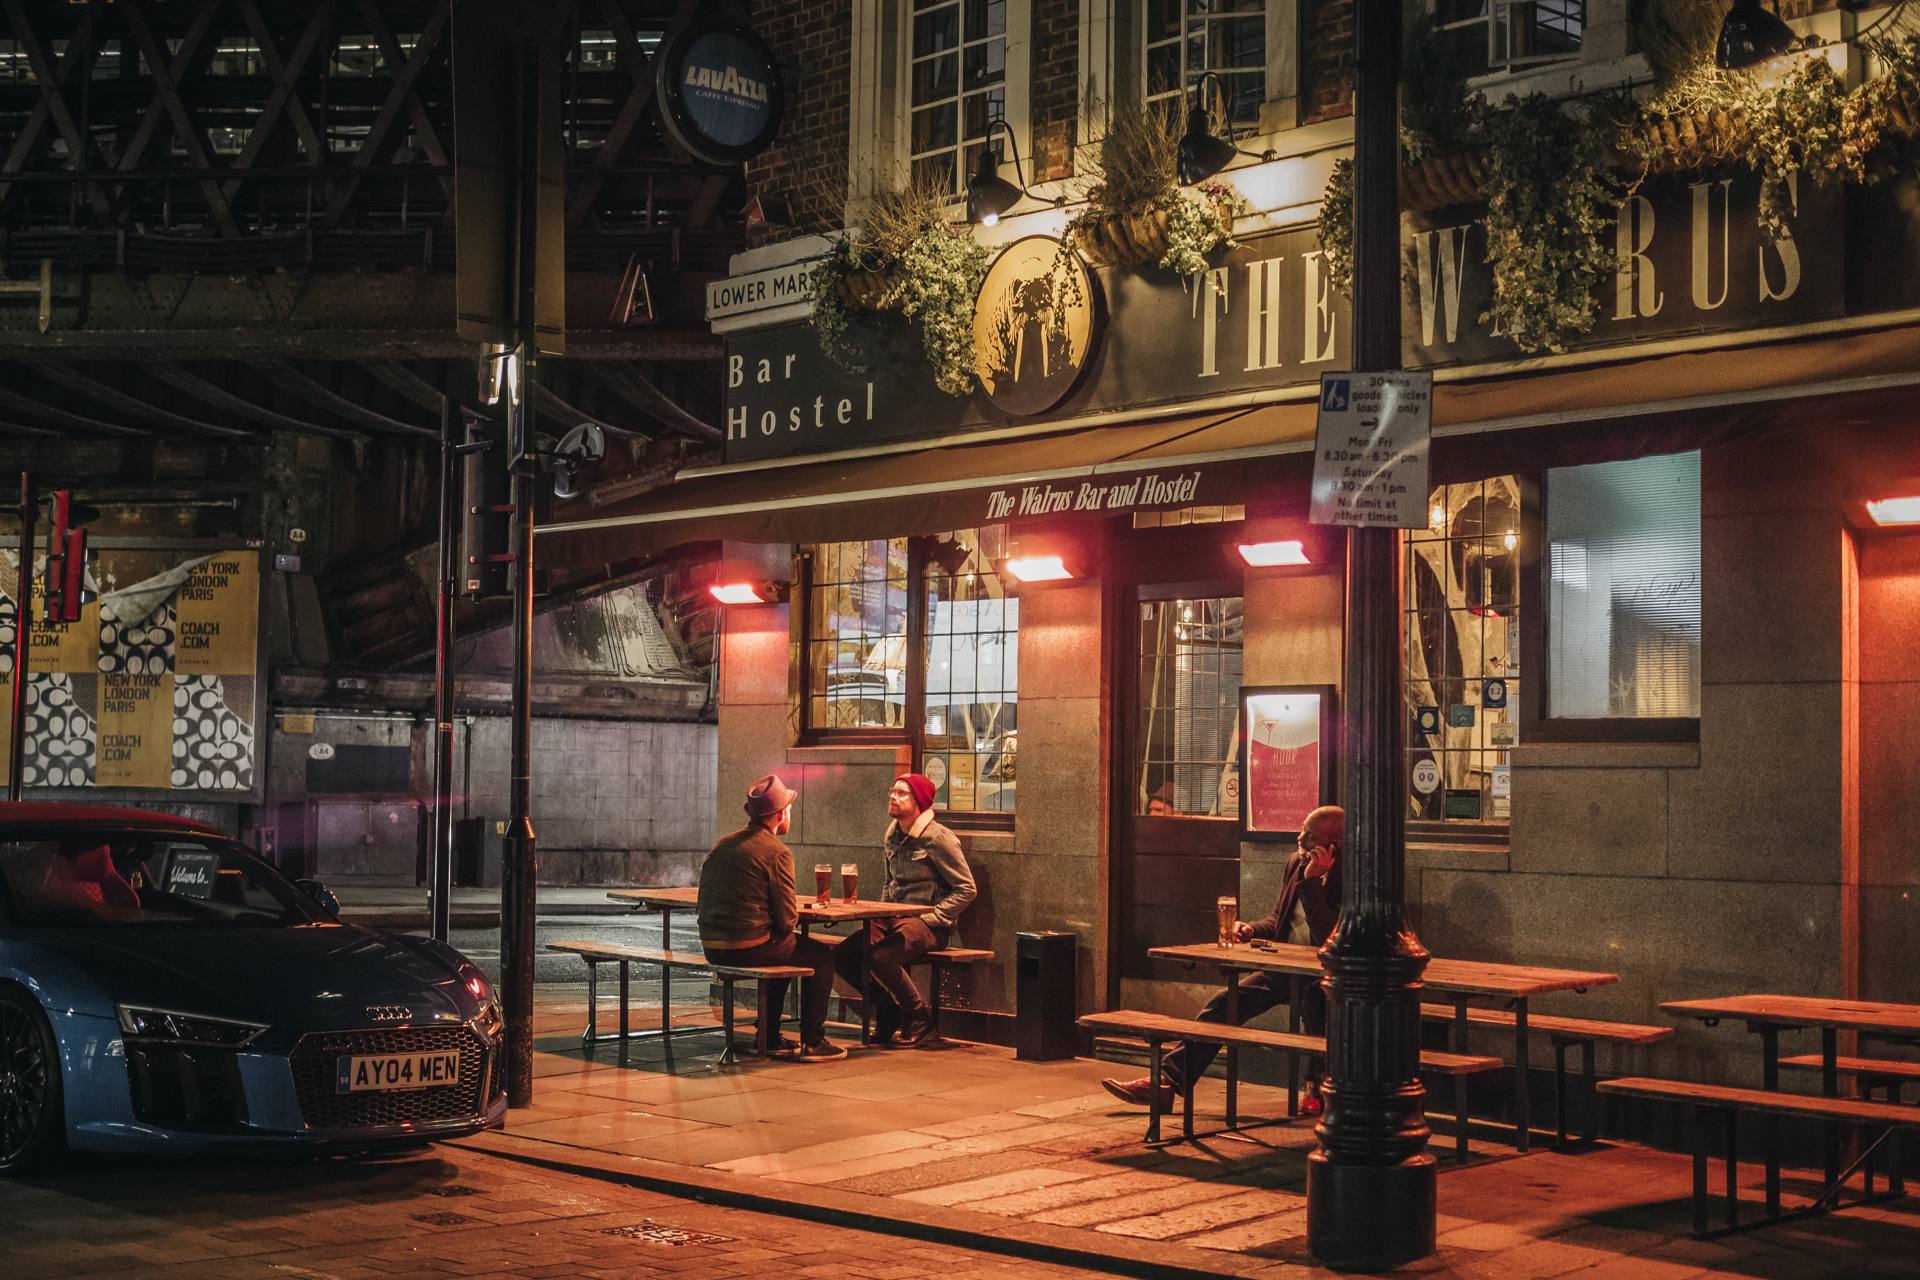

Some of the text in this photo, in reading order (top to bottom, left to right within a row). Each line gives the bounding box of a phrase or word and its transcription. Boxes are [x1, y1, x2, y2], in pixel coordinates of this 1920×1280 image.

[686, 65, 768, 103] LAVAZZA
[1192, 173, 1801, 377] THE WRUS
[713, 281, 766, 309] LOWER
[728, 353, 796, 388] Bar
[1369, 376, 1385, 388] 30
[727, 382, 874, 440] Hostel
[1397, 402, 1421, 416] only
[1348, 436, 1393, 447] Mon Fri
[985, 471, 1202, 520] The Walrus Bar and Hostel
[1337, 497, 1397, 509] No limit at
[1367, 511, 1399, 522] times
[211, 561, 240, 575] YORK
[182, 588, 214, 601] PARIS
[181, 622, 219, 635] COACH
[30, 634, 59, 648] .COM
[180, 636, 209, 649] .COM
[104, 673, 162, 688] NEW YORK
[104, 688, 150, 700] LONDON
[104, 701, 136, 713] PARIS
[102, 735, 142, 748] COACH
[102, 748, 132, 761] .COM
[356, 1055, 456, 1086] AY04 MEN
